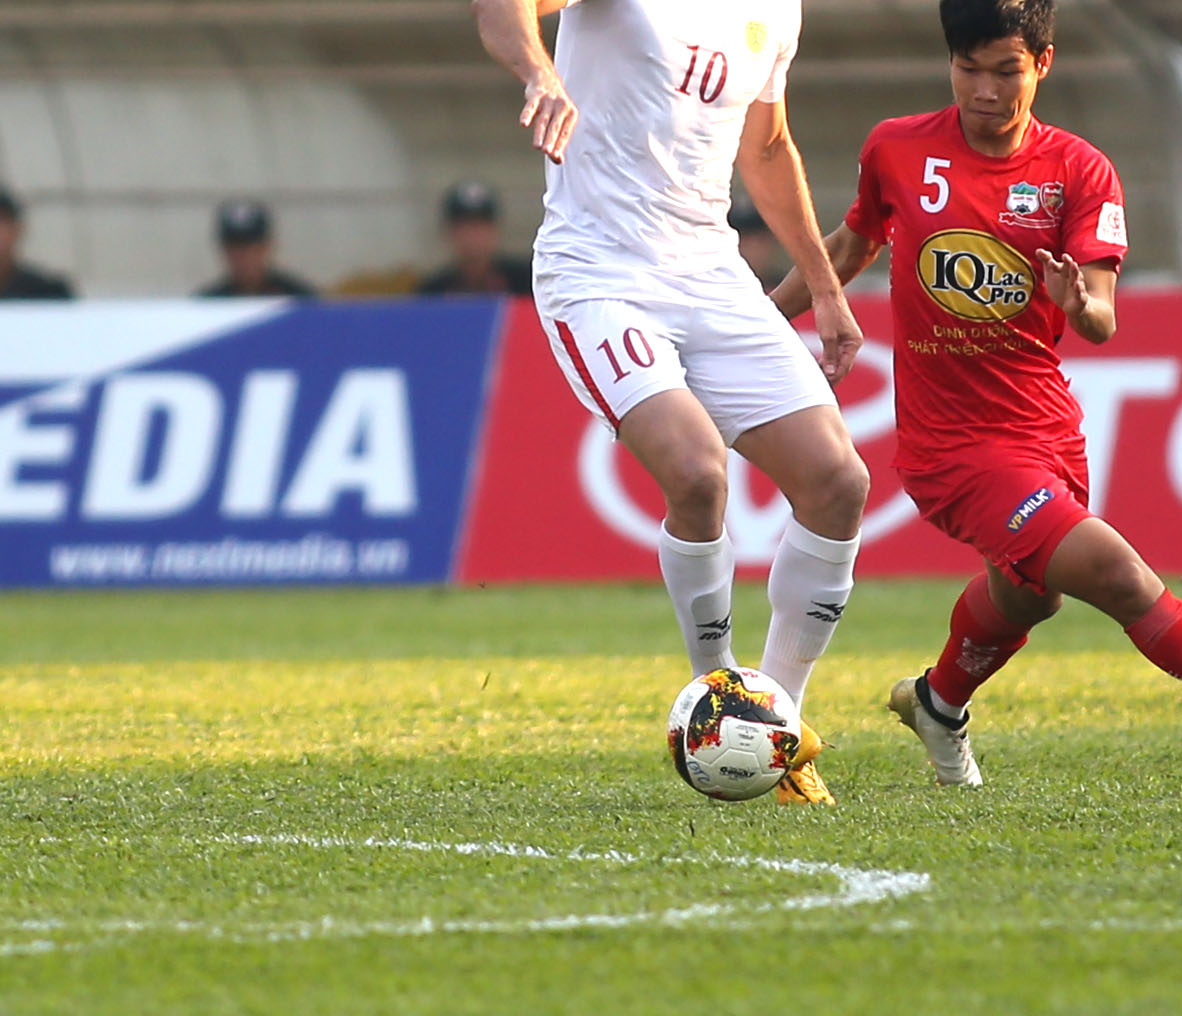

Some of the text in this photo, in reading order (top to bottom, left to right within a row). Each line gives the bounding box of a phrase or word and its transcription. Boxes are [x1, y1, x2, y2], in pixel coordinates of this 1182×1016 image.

[674, 44, 728, 104] 10
[919, 156, 951, 214] 5
[930, 249, 1026, 305] IQ Lac
[989, 287, 1028, 305] Pro
[596, 327, 656, 384] 10
[1008, 487, 1049, 530] VPMILK
